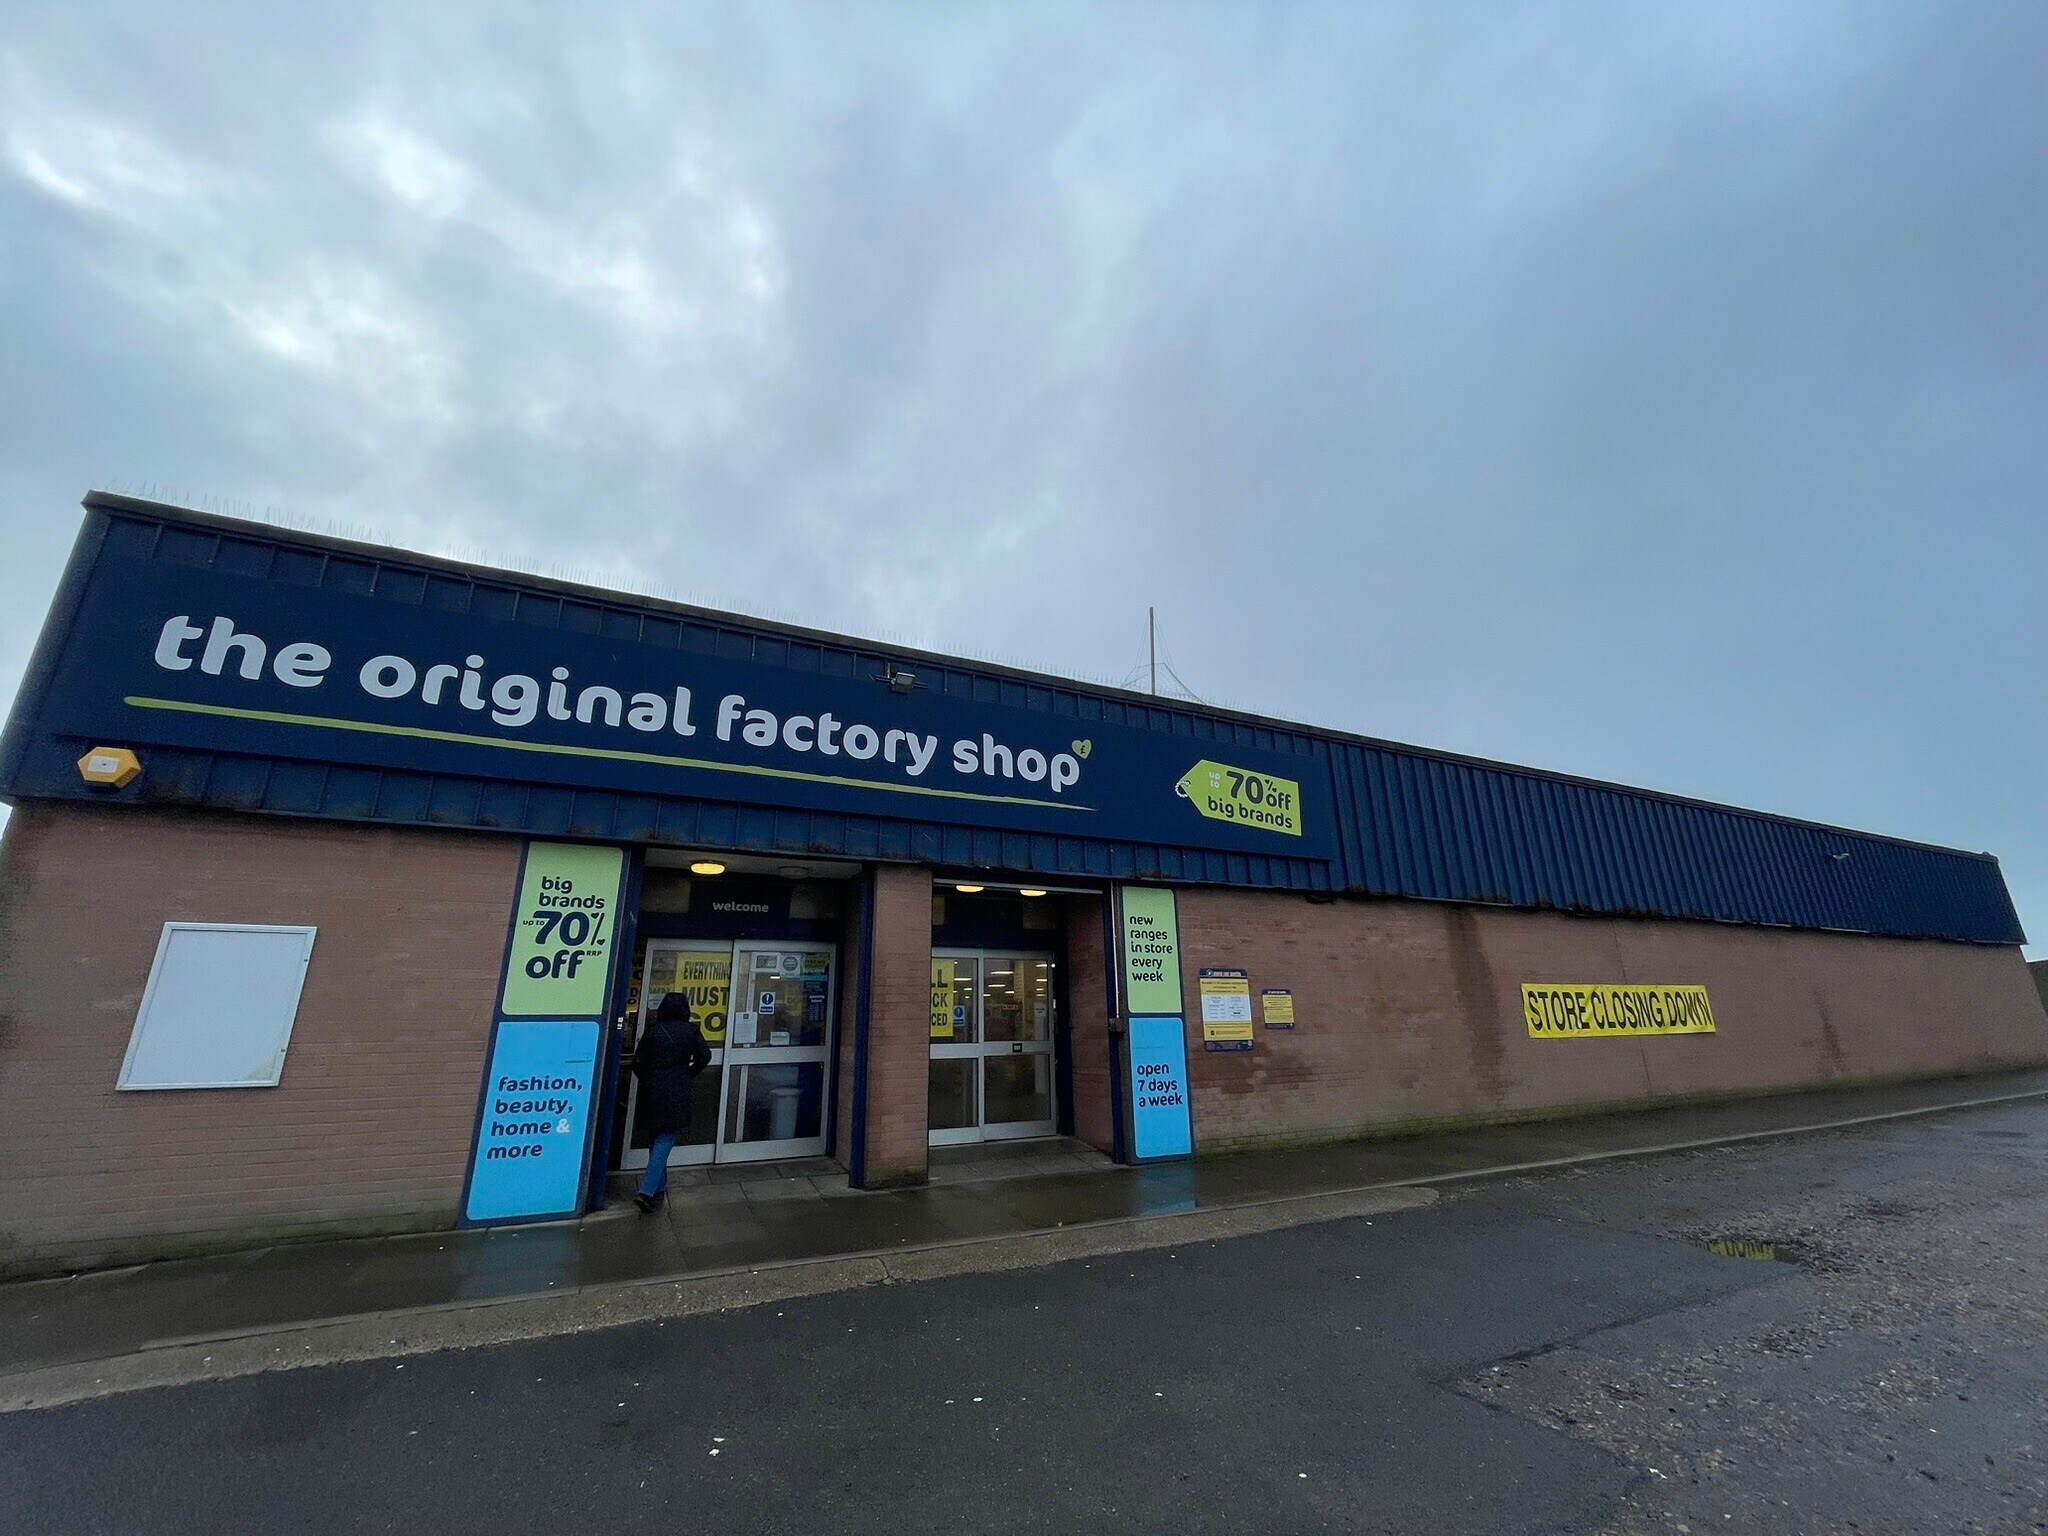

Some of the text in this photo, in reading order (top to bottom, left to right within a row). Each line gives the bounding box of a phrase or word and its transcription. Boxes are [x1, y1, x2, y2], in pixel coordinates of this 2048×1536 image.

[154, 615, 1080, 792] the original factory shop
[1208, 771, 1220, 779] up
[1210, 779, 1220, 789] to
[1265, 792, 1292, 811] off
[1208, 796, 1292, 829] big brands
[541, 875, 573, 894] big
[538, 891, 605, 909] brands
[712, 901, 769, 913] welcome
[533, 910, 606, 946] 70%
[1129, 916, 1154, 926] new
[1130, 929, 1168, 942] ranges
[1131, 941, 1173, 954] in store
[525, 949, 585, 979] off
[1131, 958, 1163, 970] every
[1132, 970, 1164, 982] week
[1527, 990, 1713, 1032] STORE CLOSING DOWN
[1136, 1064, 1170, 1078] open
[498, 1075, 583, 1092] fashion,
[1137, 1078, 1178, 1094] 7 days
[495, 1098, 574, 1115] beauty,
[1138, 1092, 1184, 1107] a week
[491, 1118, 570, 1136] home &
[486, 1144, 543, 1159] more
